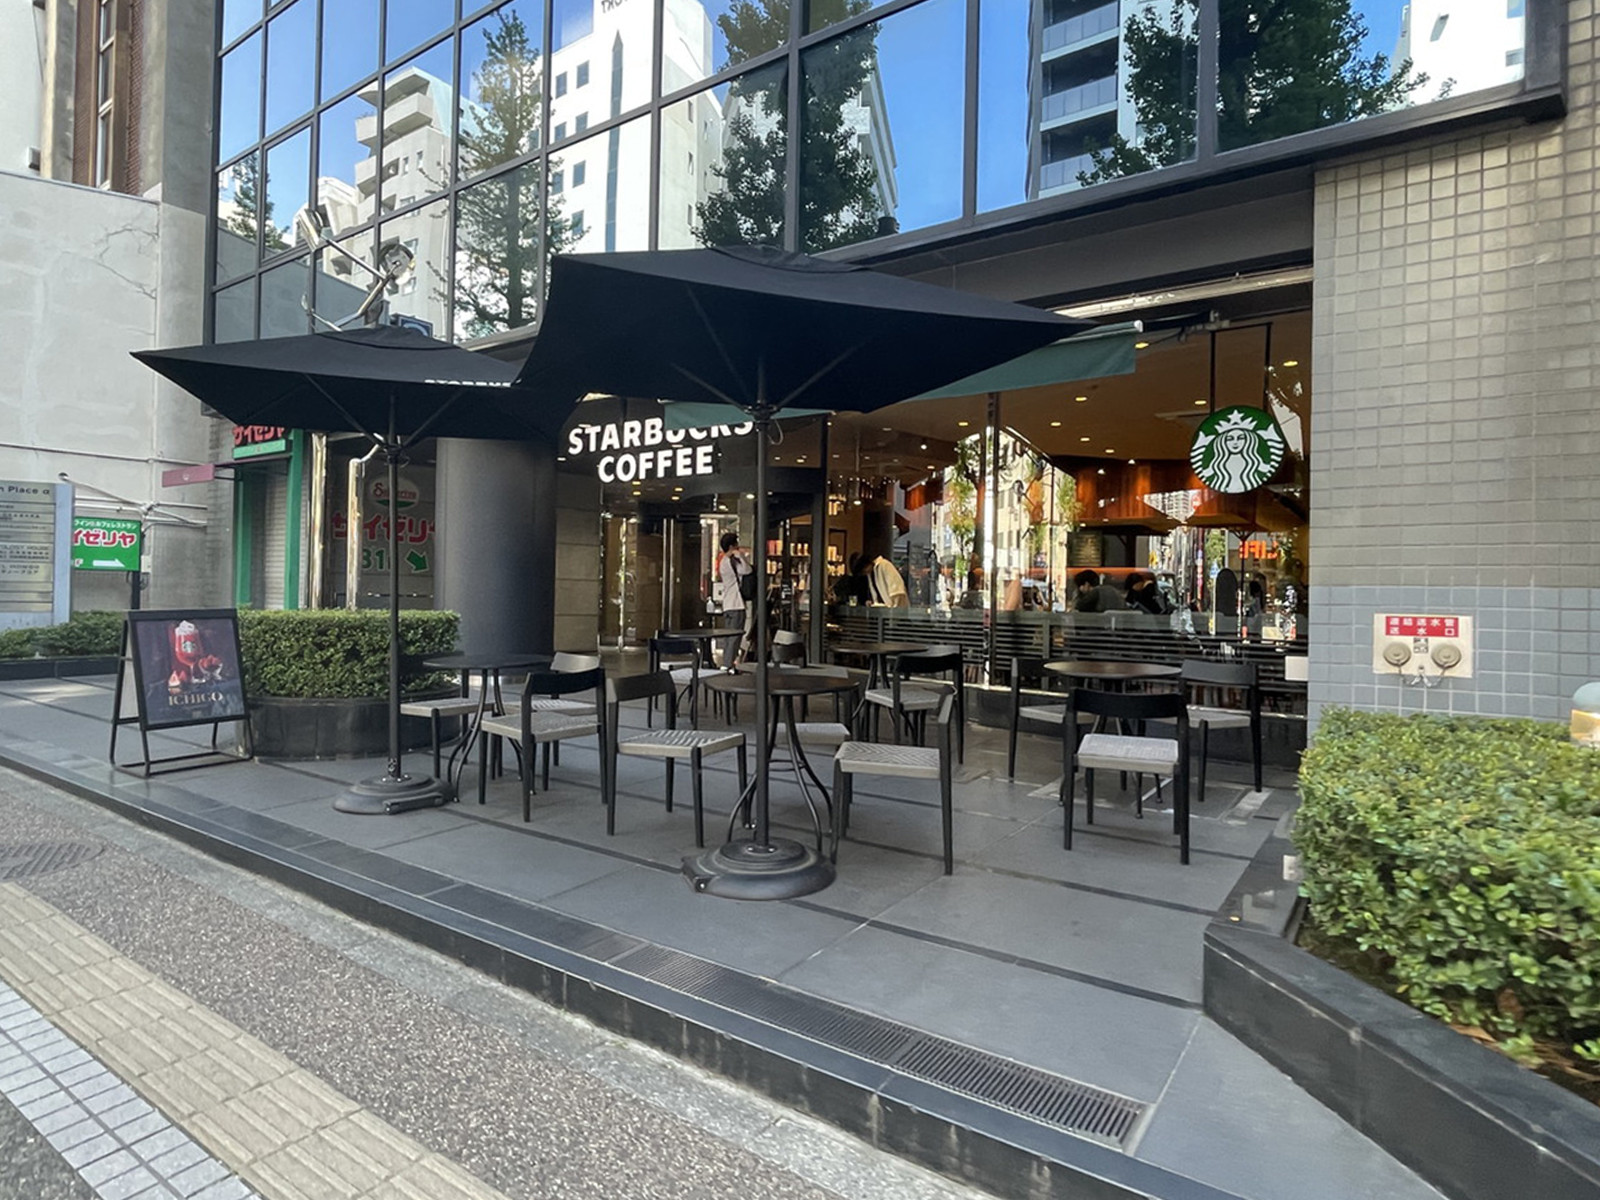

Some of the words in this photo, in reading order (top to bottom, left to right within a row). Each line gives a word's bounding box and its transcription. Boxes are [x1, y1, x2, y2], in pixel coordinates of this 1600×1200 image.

[598, 445, 714, 483] COFFEE
[8, 485, 39, 495] Place
[332, 512, 435, 544] サイゼリ
[169, 691, 223, 706] ICHIGO
